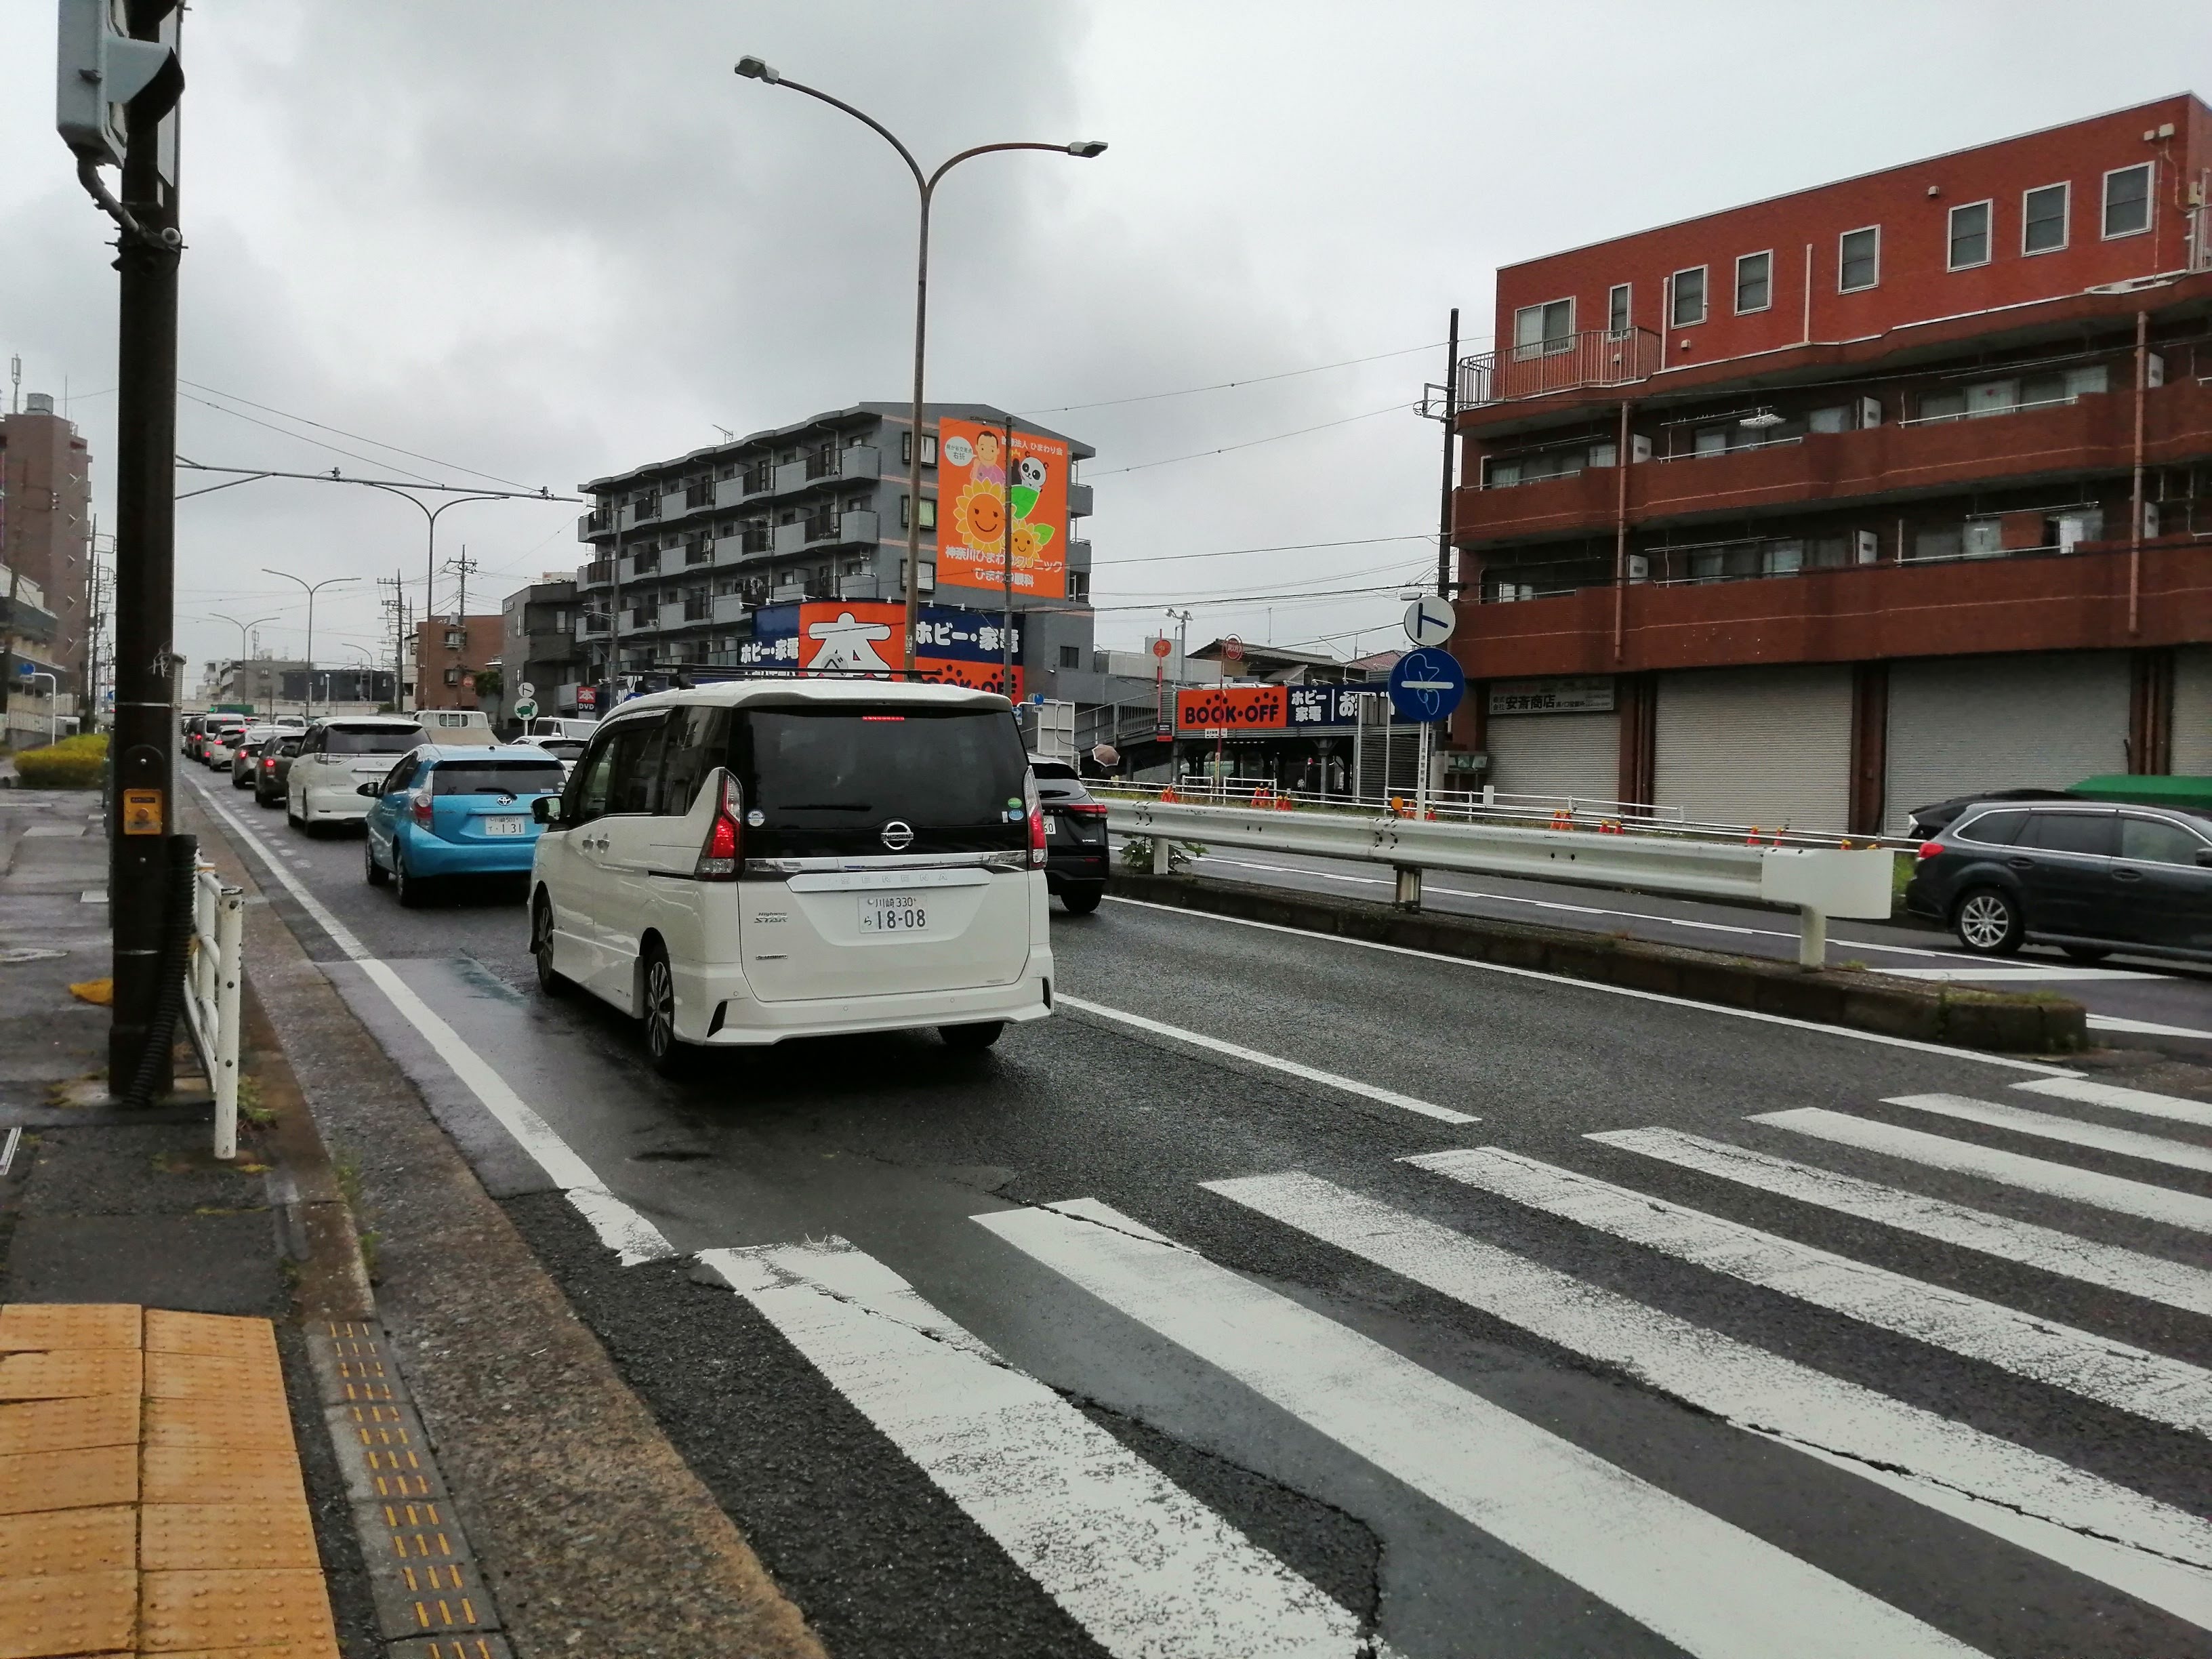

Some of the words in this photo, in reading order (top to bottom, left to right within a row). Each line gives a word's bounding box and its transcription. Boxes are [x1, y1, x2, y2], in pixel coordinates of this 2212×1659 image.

[1030, 443, 1063, 455] ひまわり会
[954, 451, 966, 460] 右折
[1292, 690, 1326, 705] ホビー
[1295, 706, 1322, 722] 家電
[841, 873, 948, 884] SERENA
[875, 898, 895, 908] 川崎
[896, 897, 913, 907] 330
[864, 916, 872, 926] ら
[878, 909, 926, 929] 18-08
